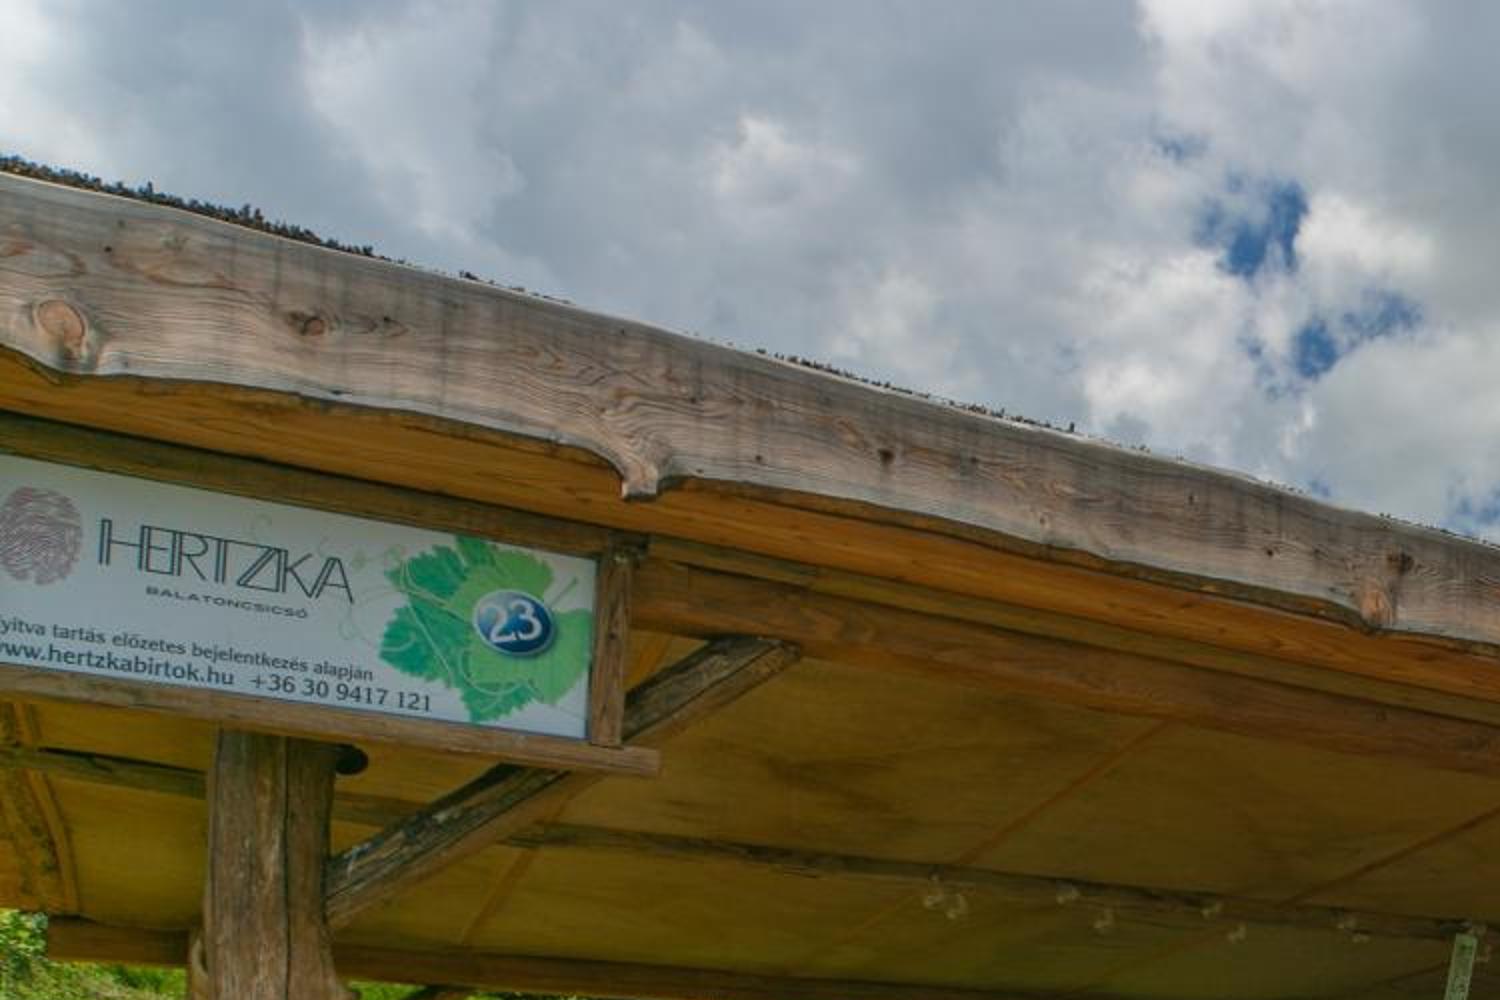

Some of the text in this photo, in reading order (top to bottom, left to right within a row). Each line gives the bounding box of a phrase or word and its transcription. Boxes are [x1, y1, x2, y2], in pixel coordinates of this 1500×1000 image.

[98, 518, 354, 605] HERTZKA
[0, 616, 46, 635] yitva
[479, 599, 543, 643] 23
[0, 642, 432, 712] ww.hertzkabirtok.hu +36 30 9417 121
